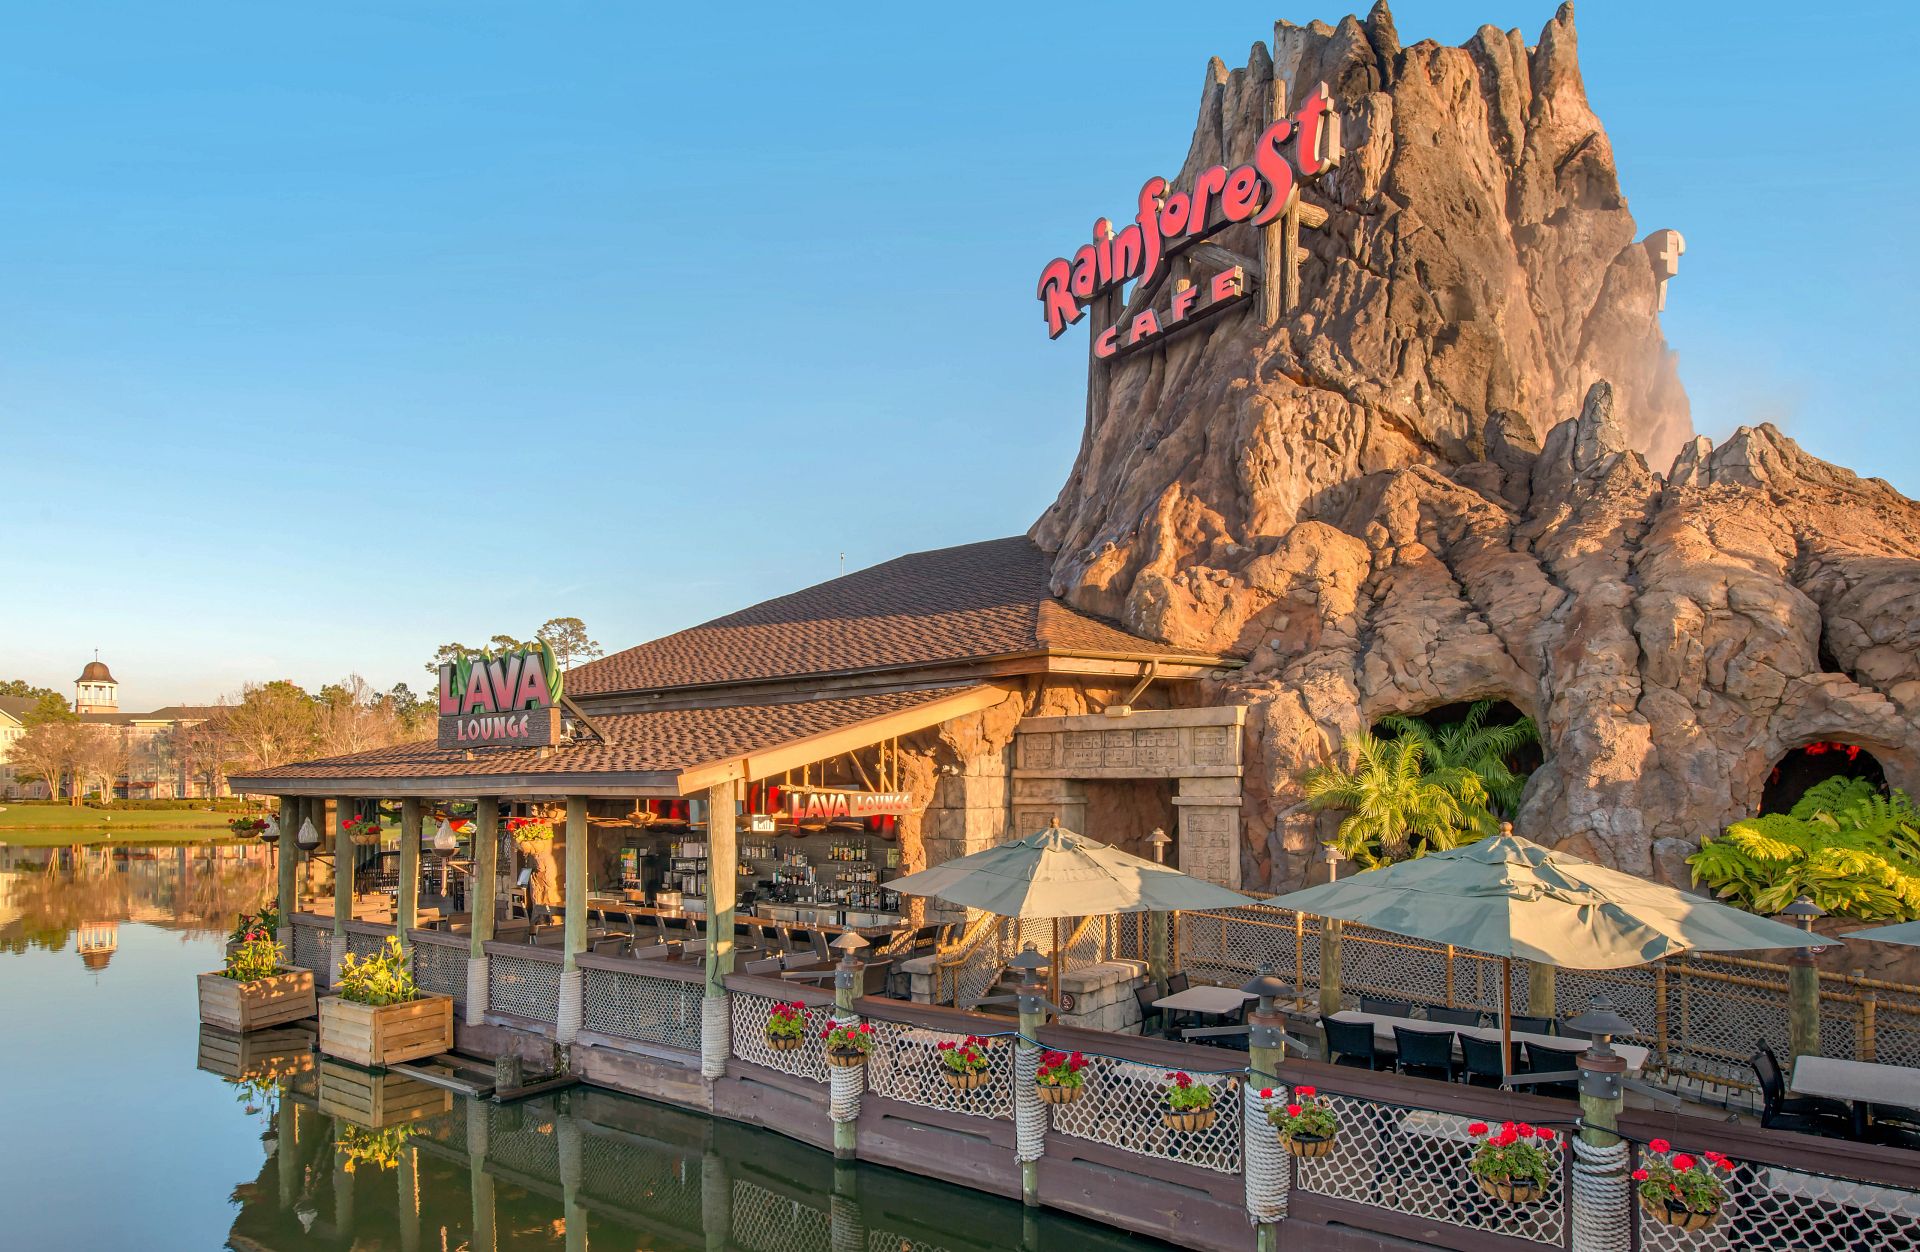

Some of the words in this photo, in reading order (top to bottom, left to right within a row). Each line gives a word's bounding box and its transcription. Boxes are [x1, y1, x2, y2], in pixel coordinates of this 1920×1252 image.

[1037, 82, 1334, 340] Rainforest
[1094, 266, 1242, 359] CAFE
[439, 653, 550, 715] LAVA
[456, 714, 530, 742] LOUNGE
[792, 793, 850, 818] LAVA
[857, 794, 909, 811] LOUNGE
